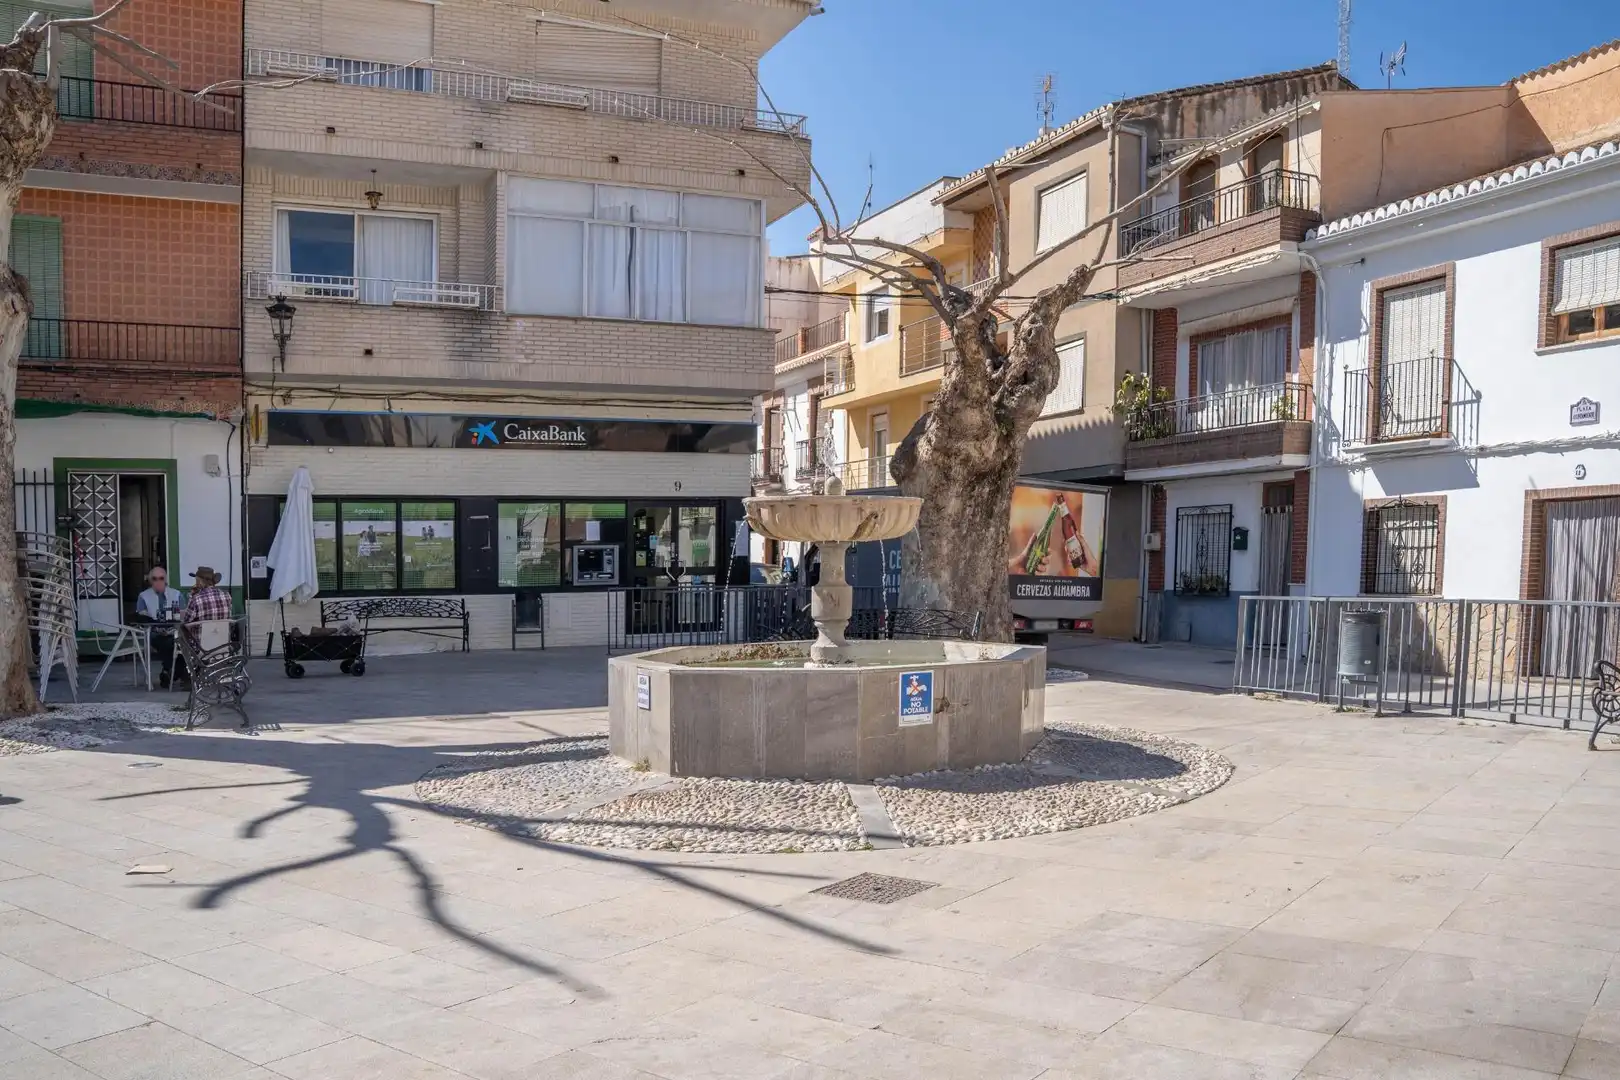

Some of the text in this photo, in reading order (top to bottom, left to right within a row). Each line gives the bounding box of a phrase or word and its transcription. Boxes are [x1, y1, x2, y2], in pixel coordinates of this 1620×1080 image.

[503, 423, 587, 441] CaixaBank
[674, 480, 682, 492] 9
[1016, 584, 1091, 597] CERVEZAS ALHAMBRA
[903, 706, 929, 715] POTABLE
